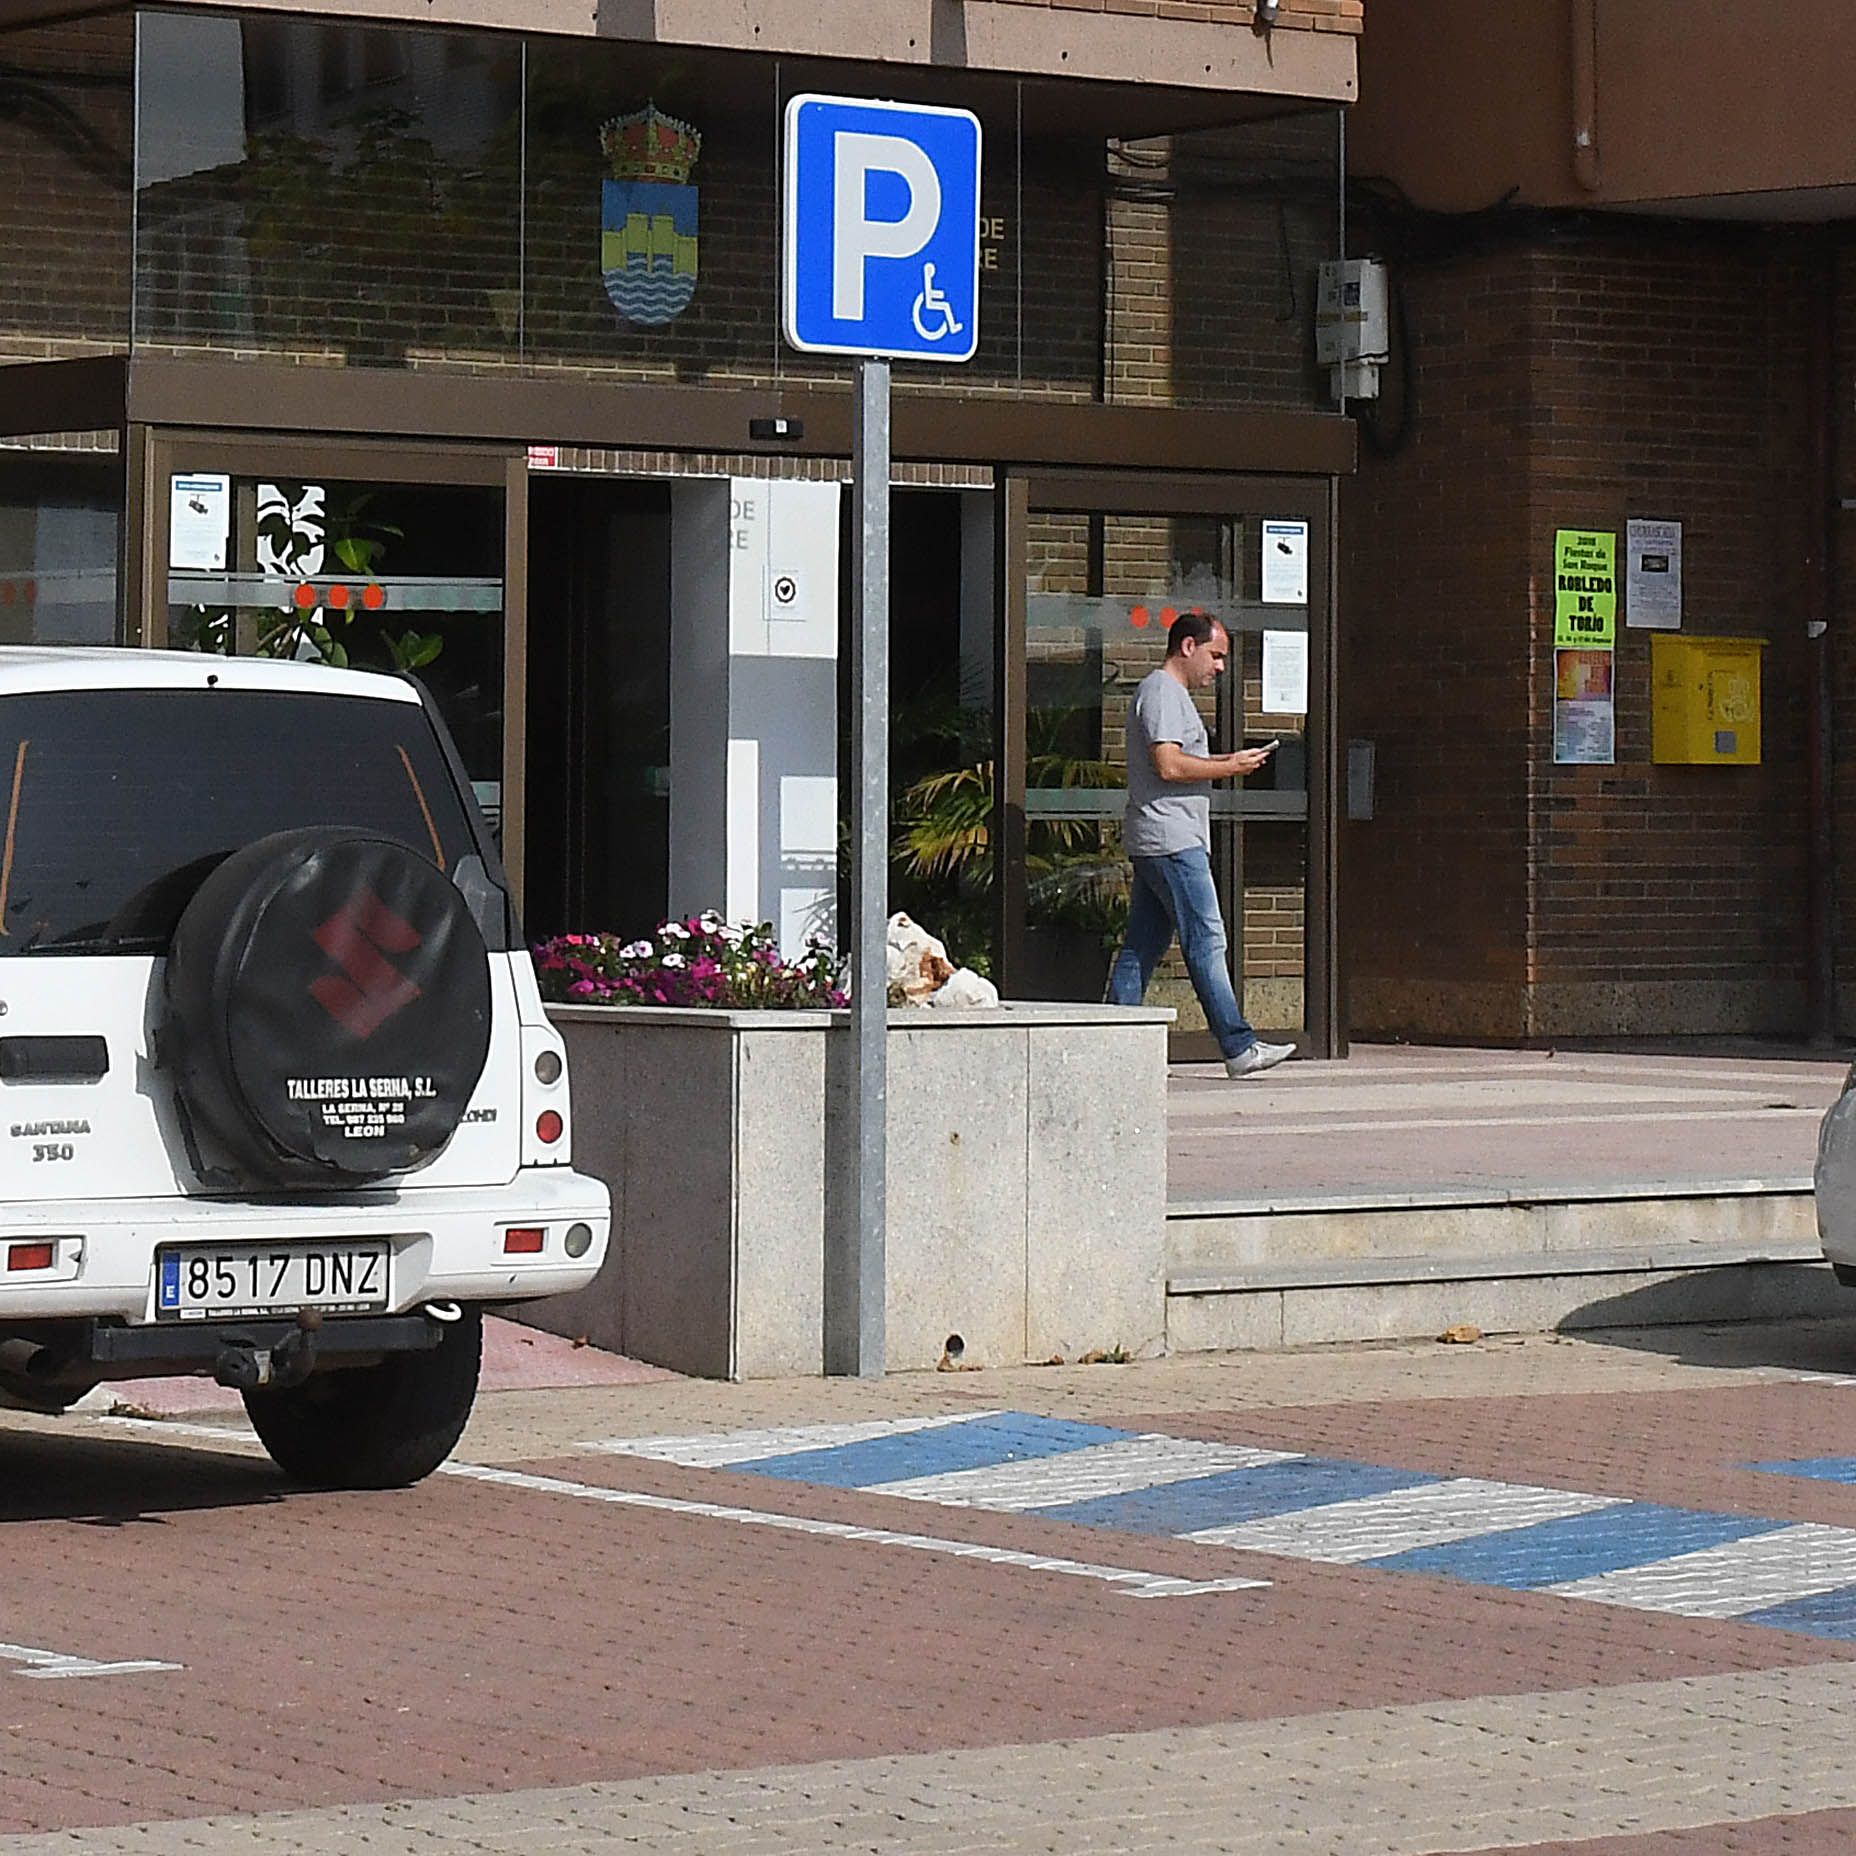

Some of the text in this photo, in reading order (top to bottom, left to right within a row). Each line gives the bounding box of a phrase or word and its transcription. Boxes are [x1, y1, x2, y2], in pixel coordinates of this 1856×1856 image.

[832, 130, 942, 321] P
[1558, 574, 1612, 594] ROBLEDO
[1578, 596, 1594, 612] DE
[1568, 612, 1604, 632] TORÍO
[286, 1076, 437, 1101] TALLERES LA SERNA, S.L.
[321, 1103, 336, 1114] LA
[9, 1119, 91, 1137] SANTANA
[323, 1115, 346, 1125] TEL.
[344, 1125, 385, 1138] LEON
[32, 1143, 74, 1162] 350
[188, 1251, 379, 1300] 8517 DNZ
[165, 1284, 176, 1298] E
